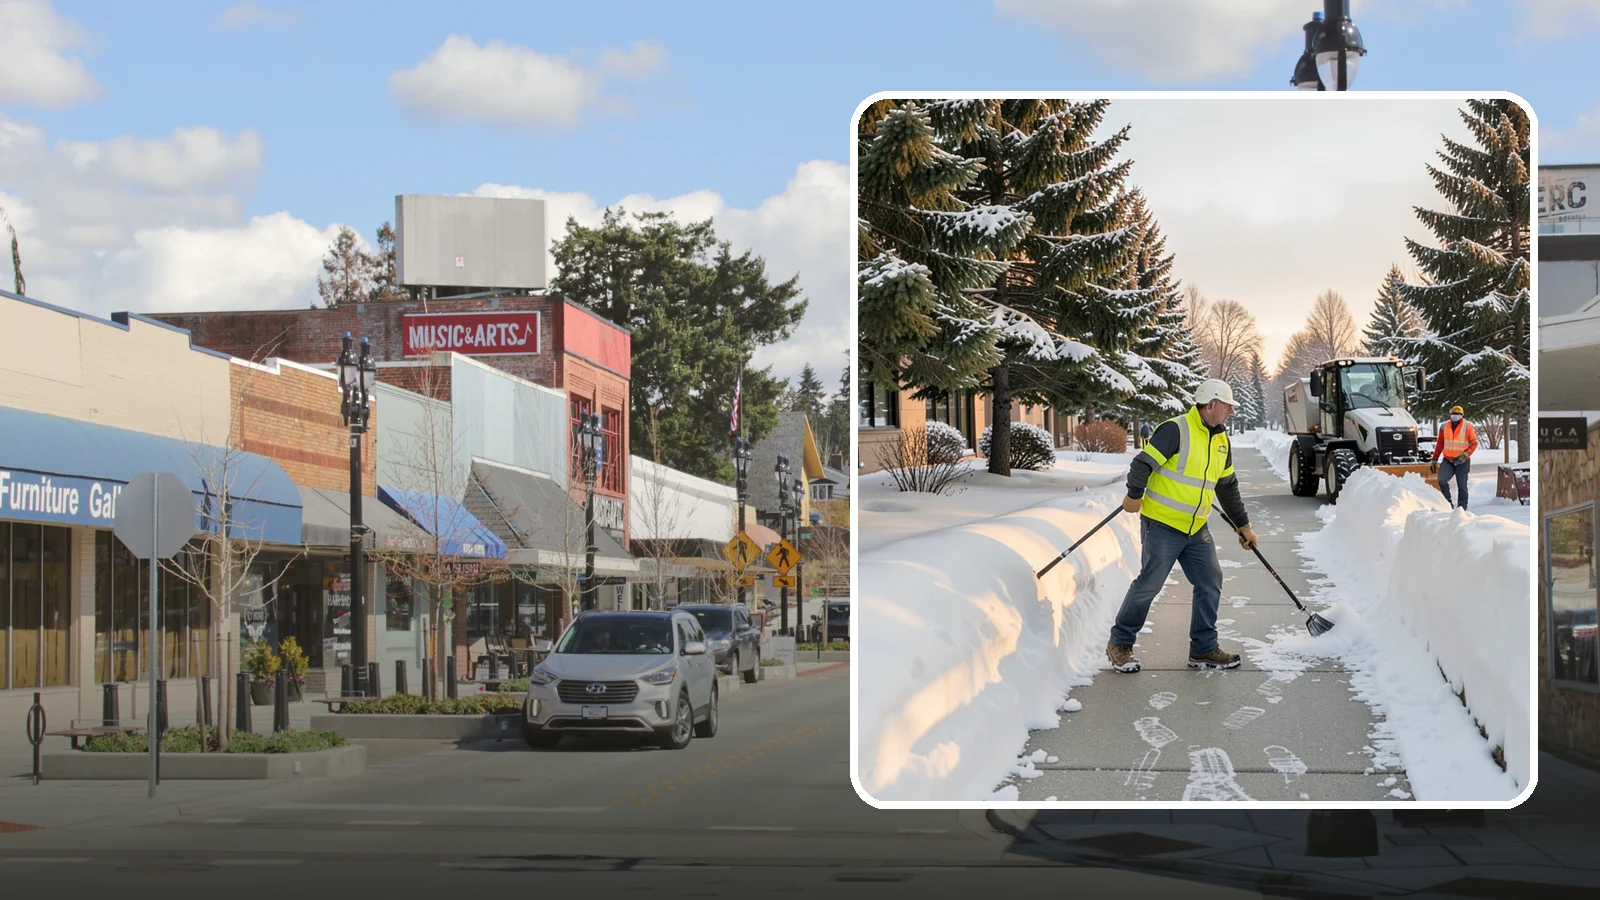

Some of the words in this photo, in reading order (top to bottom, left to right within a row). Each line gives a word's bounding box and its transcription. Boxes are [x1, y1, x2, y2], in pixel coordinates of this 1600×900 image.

[409, 323, 519, 348] MUSIC&ARTS
[1540, 427, 1577, 437] UGA
[0, 471, 79, 515] Furniture
[89, 482, 121, 519] Gal
[453, 563, 479, 574] SUSHI
